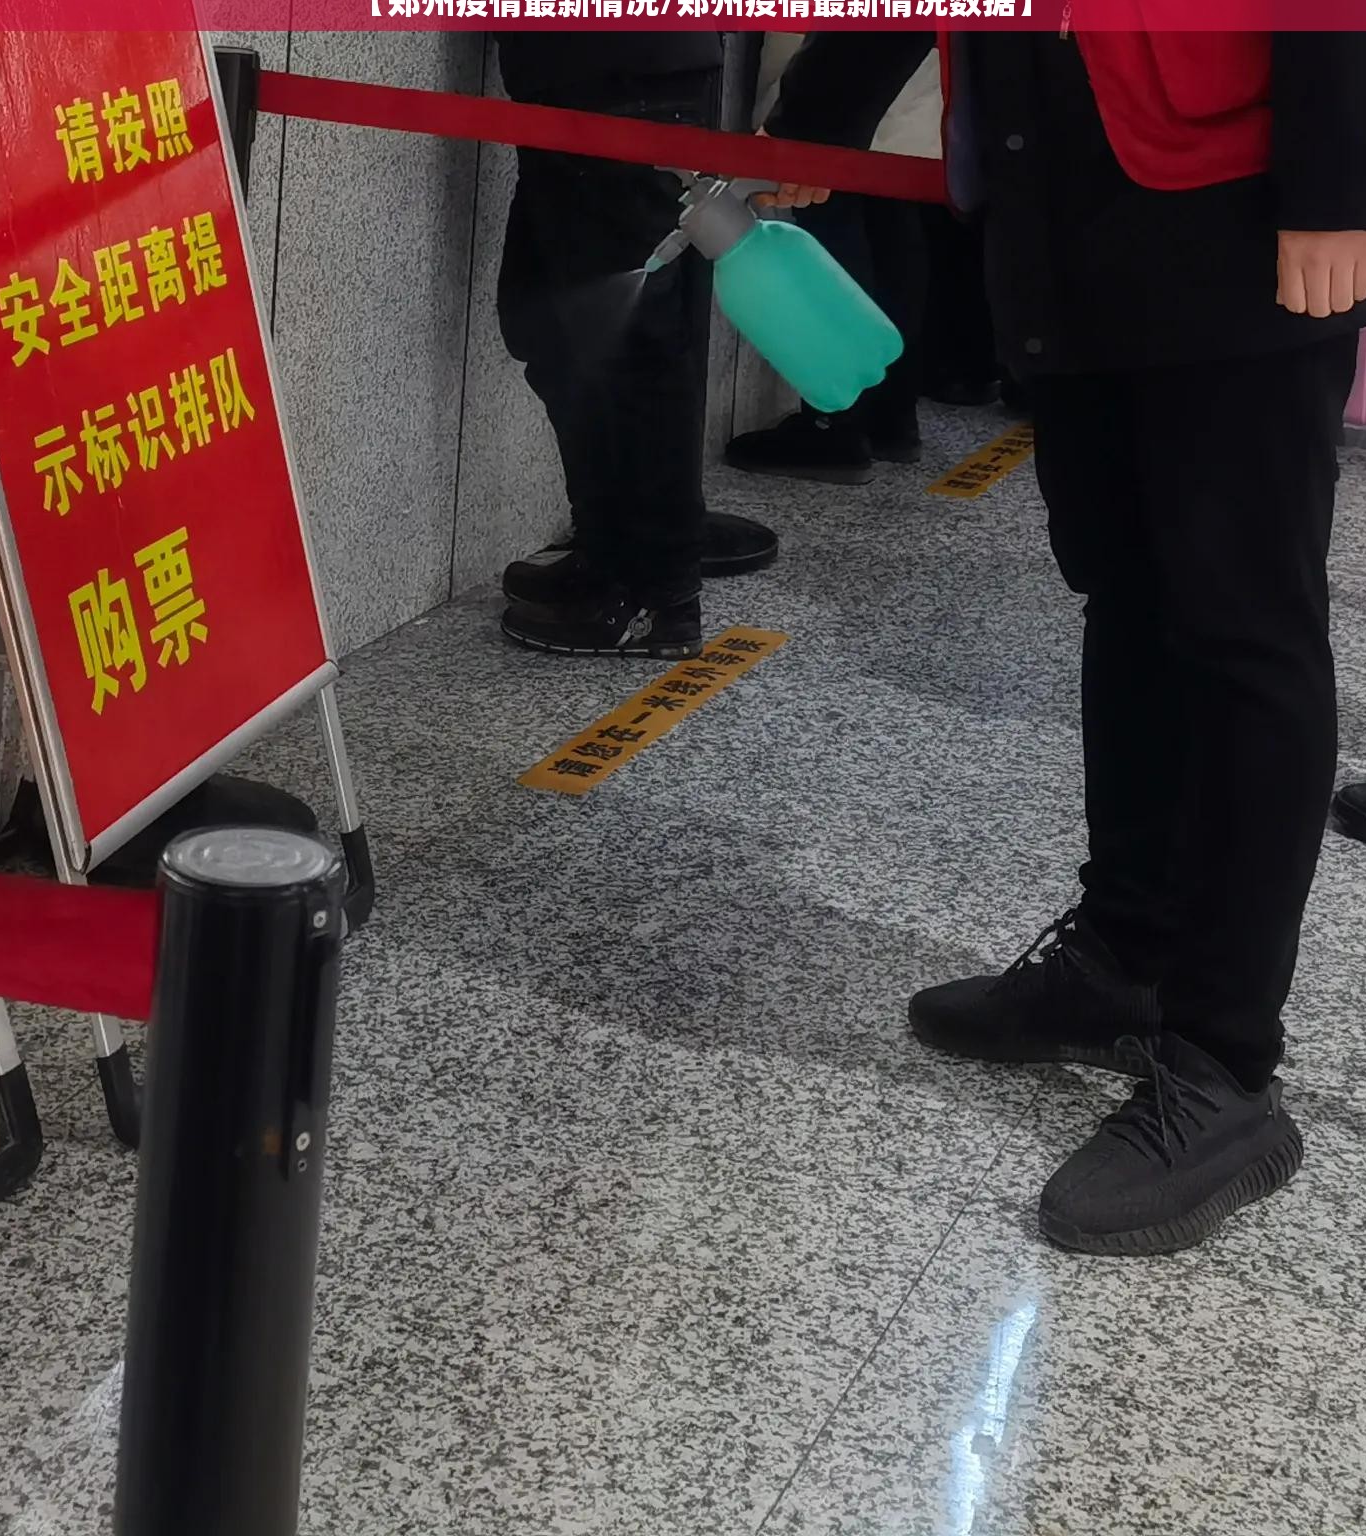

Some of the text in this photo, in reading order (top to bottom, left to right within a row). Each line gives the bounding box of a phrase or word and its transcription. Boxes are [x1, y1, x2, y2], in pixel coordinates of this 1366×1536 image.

[55, 77, 193, 184] 请按照
[34, 347, 256, 516] 示标识排队
[68, 526, 208, 715] 购票
[547, 636, 767, 777] 请您在一米线外等候
